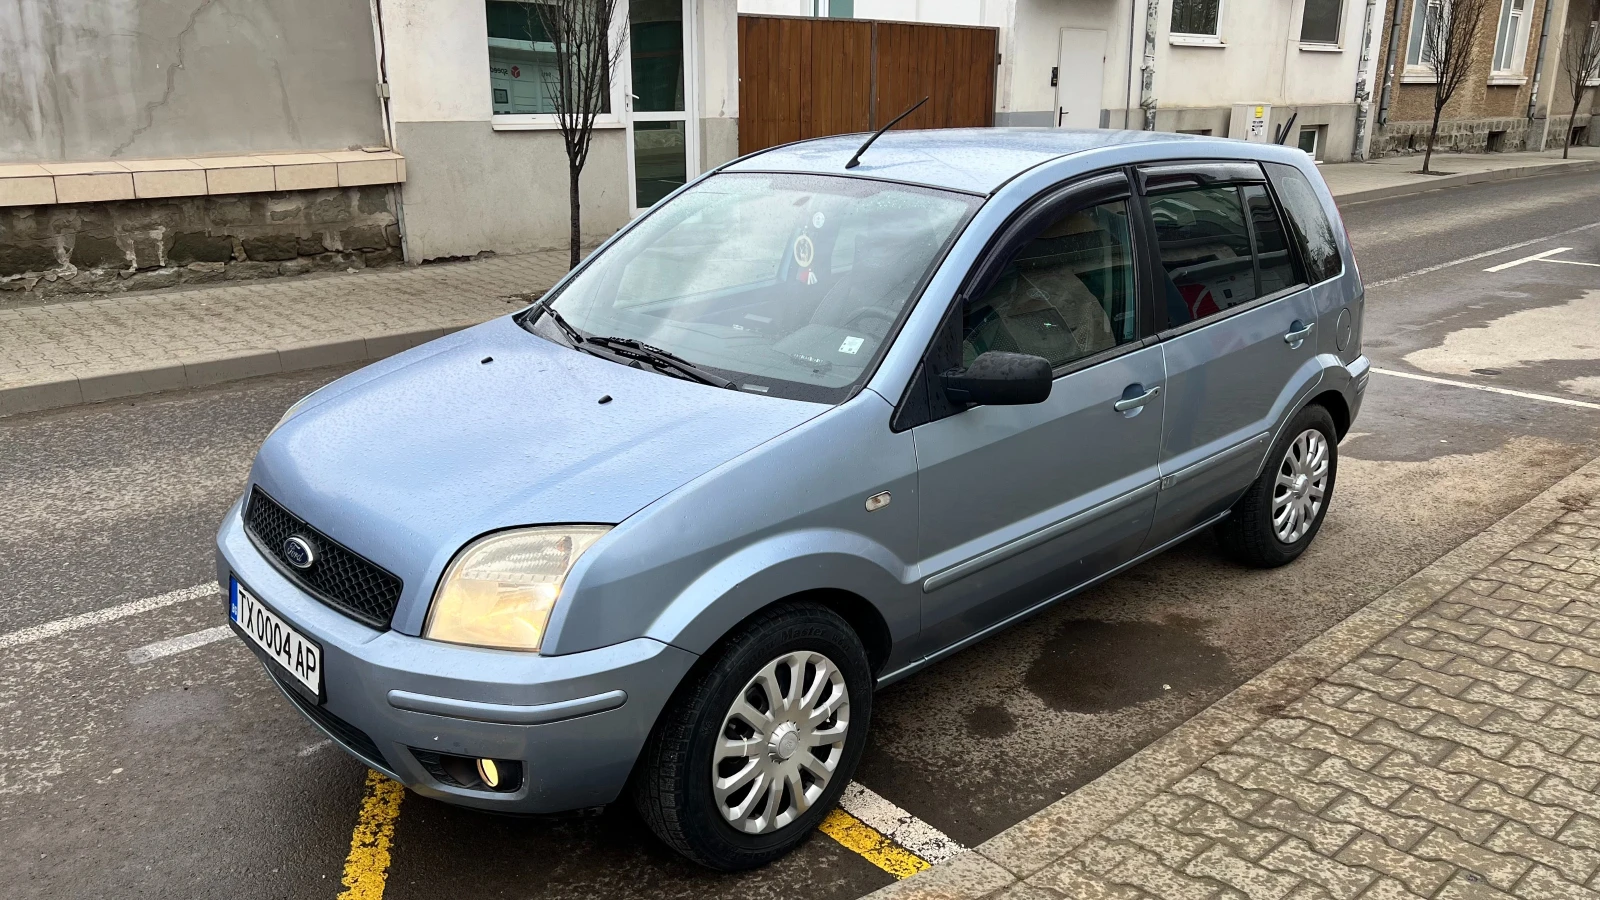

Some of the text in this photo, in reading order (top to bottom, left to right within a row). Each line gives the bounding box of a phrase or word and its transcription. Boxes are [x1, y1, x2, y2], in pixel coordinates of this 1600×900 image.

[287, 541, 304, 562] Ford
[257, 608, 292, 666] 0004
[295, 640, 316, 681] AP
